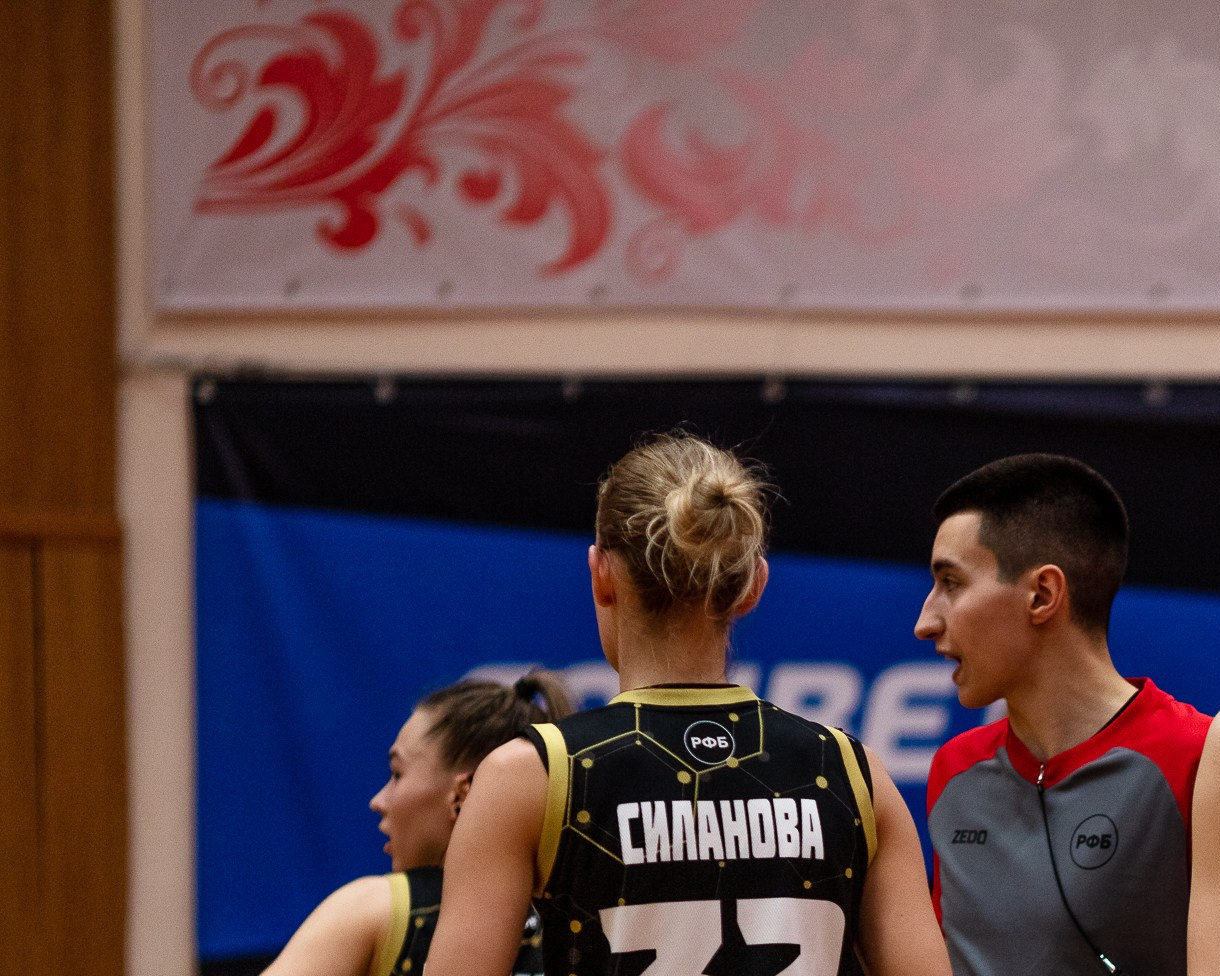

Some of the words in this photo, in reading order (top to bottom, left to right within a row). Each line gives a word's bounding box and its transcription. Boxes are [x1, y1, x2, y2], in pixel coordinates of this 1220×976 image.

[690, 733, 730, 751] РФБ
[616, 797, 825, 866] СИЛАНОВА
[951, 829, 988, 846] ZEDO
[1075, 832, 1113, 851] РФБ
